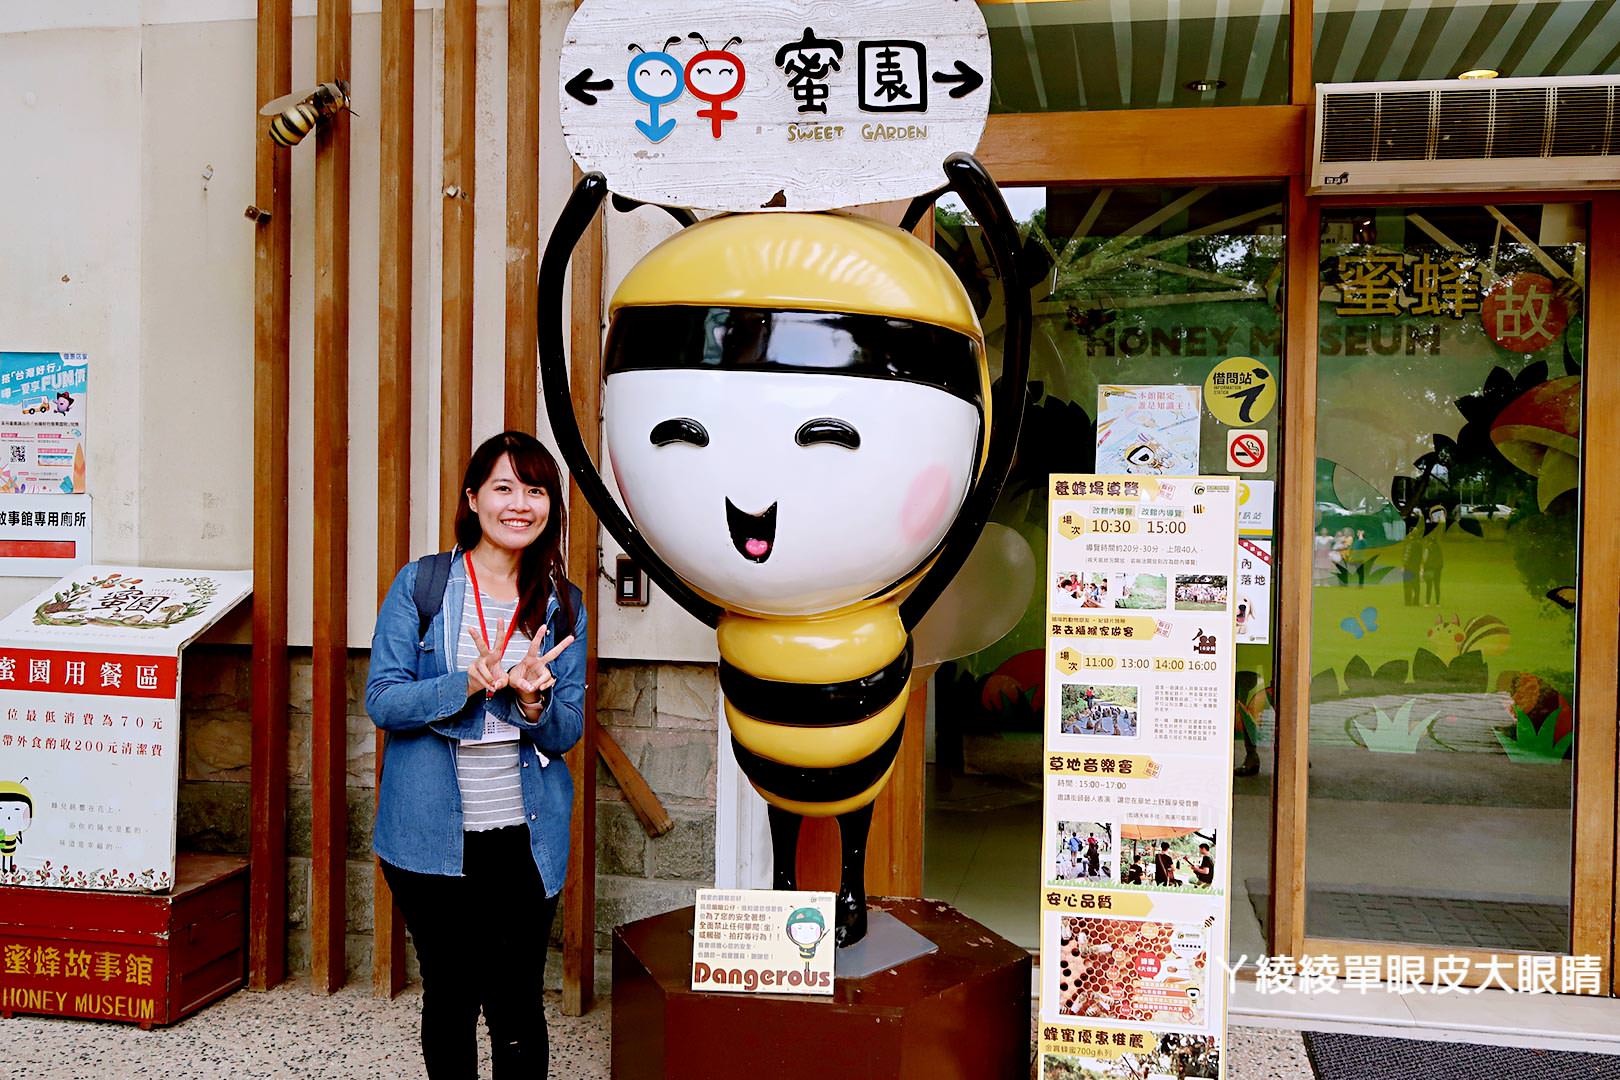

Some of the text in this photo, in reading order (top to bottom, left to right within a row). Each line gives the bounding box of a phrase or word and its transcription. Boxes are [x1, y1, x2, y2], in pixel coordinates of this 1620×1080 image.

[775, 27, 928, 115] 蜜園
[787, 124, 929, 143] SWEET GARDEN
[1337, 253, 1554, 342] 蜜蜂 故
[1086, 326, 1248, 357] HONEY
[1212, 372, 1253, 385] 借問站
[1055, 480, 1139, 497] 養蜂場導覽
[1092, 519, 1187, 534] 10:30 15:00
[0, 656, 159, 690] 蜜園用餐區
[1085, 657, 1217, 671] 11:00 13:00 14:00 16:00
[1049, 756, 1133, 774] 草地音樂會
[1046, 891, 1113, 910] 安心品質
[4, 943, 154, 987] 蜜蜂故事館
[694, 962, 831, 991] Dangerous
[3, 987, 155, 1020] HONEY MUSEUM
[1043, 1026, 1144, 1049] 蜂蜜優惠推薦
